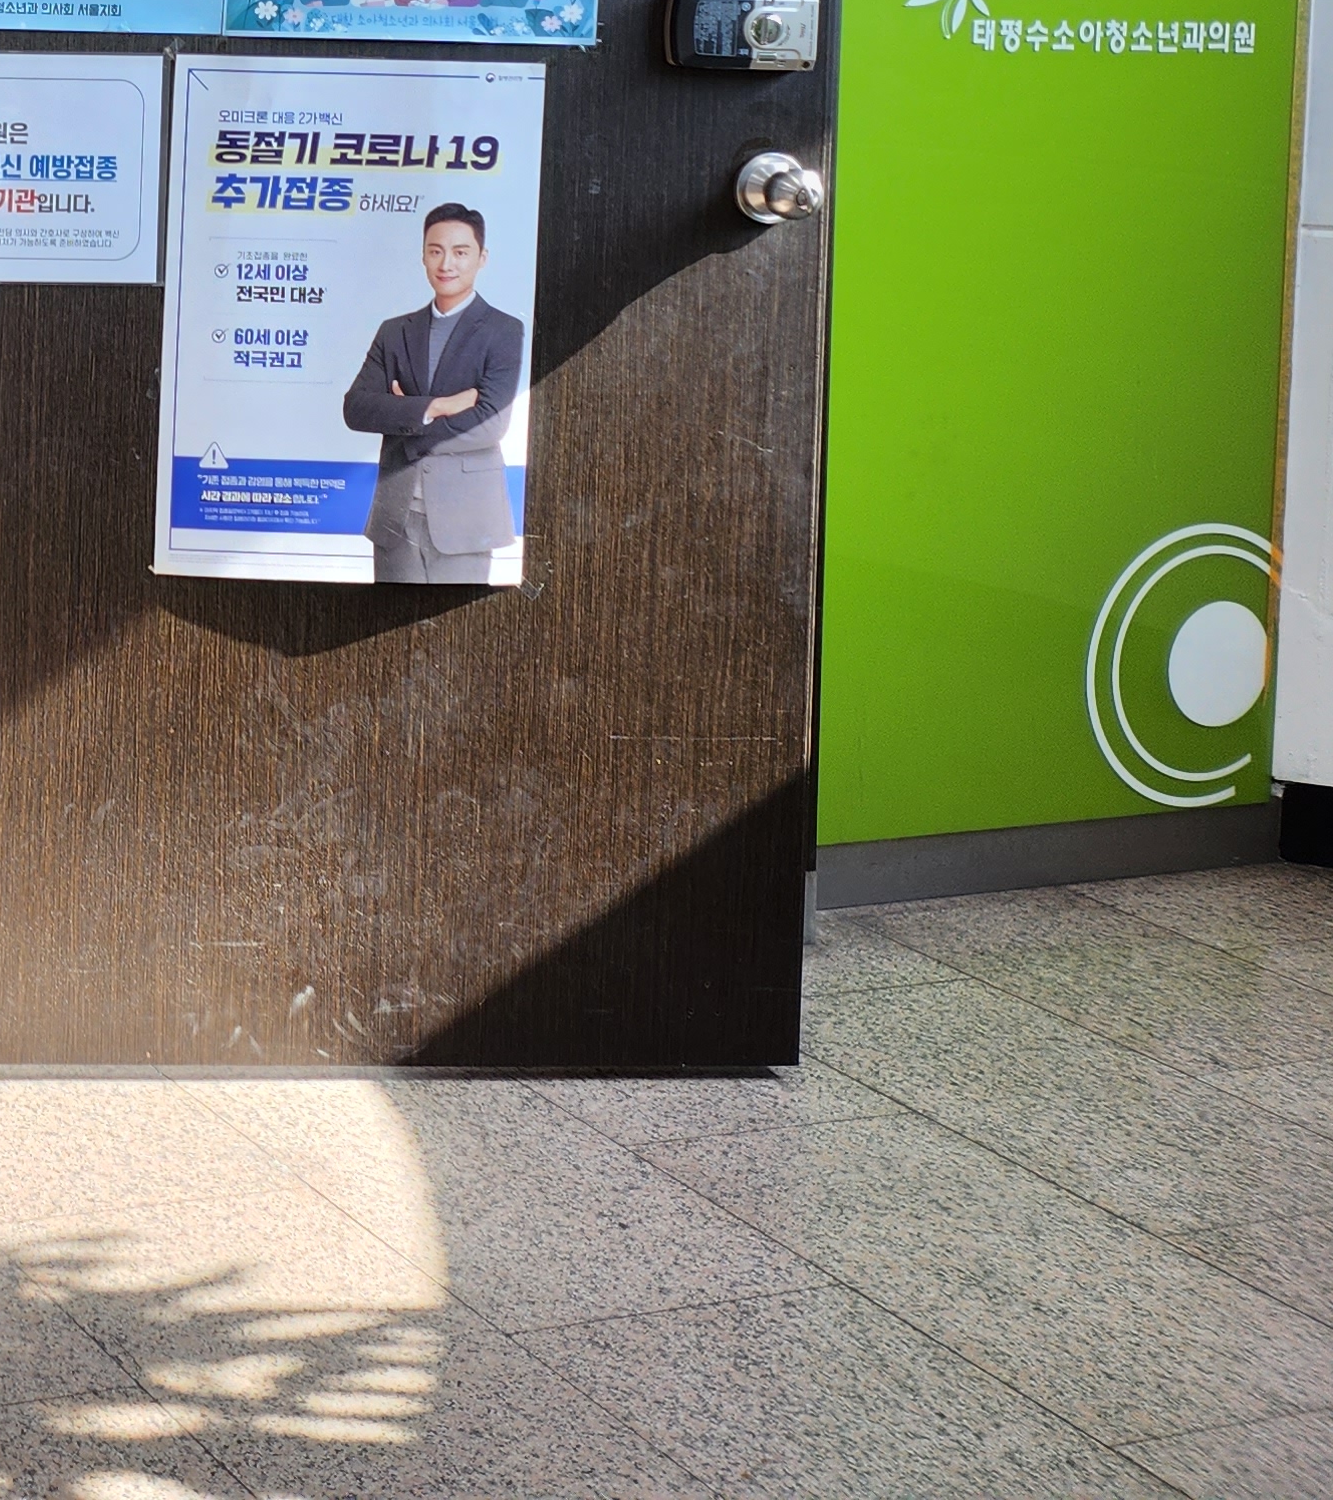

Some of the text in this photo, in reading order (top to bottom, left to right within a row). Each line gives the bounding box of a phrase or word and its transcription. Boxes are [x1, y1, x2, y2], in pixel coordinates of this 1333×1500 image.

[41, 2, 74, 16] 의사회
[972, 18, 1257, 55] 태평수소아청소년과의원
[218, 109, 268, 125] 오미크론
[271, 110, 296, 125] 대응
[213, 129, 500, 171] 동절기 코로나 19
[29, 155, 118, 181] 예방접종
[210, 173, 354, 212] 추가접종
[236, 263, 309, 281] 12세 이상
[236, 285, 325, 304] 전국민 대상
[234, 328, 309, 347] 60세 이상
[233, 350, 303, 368] 적극권고
